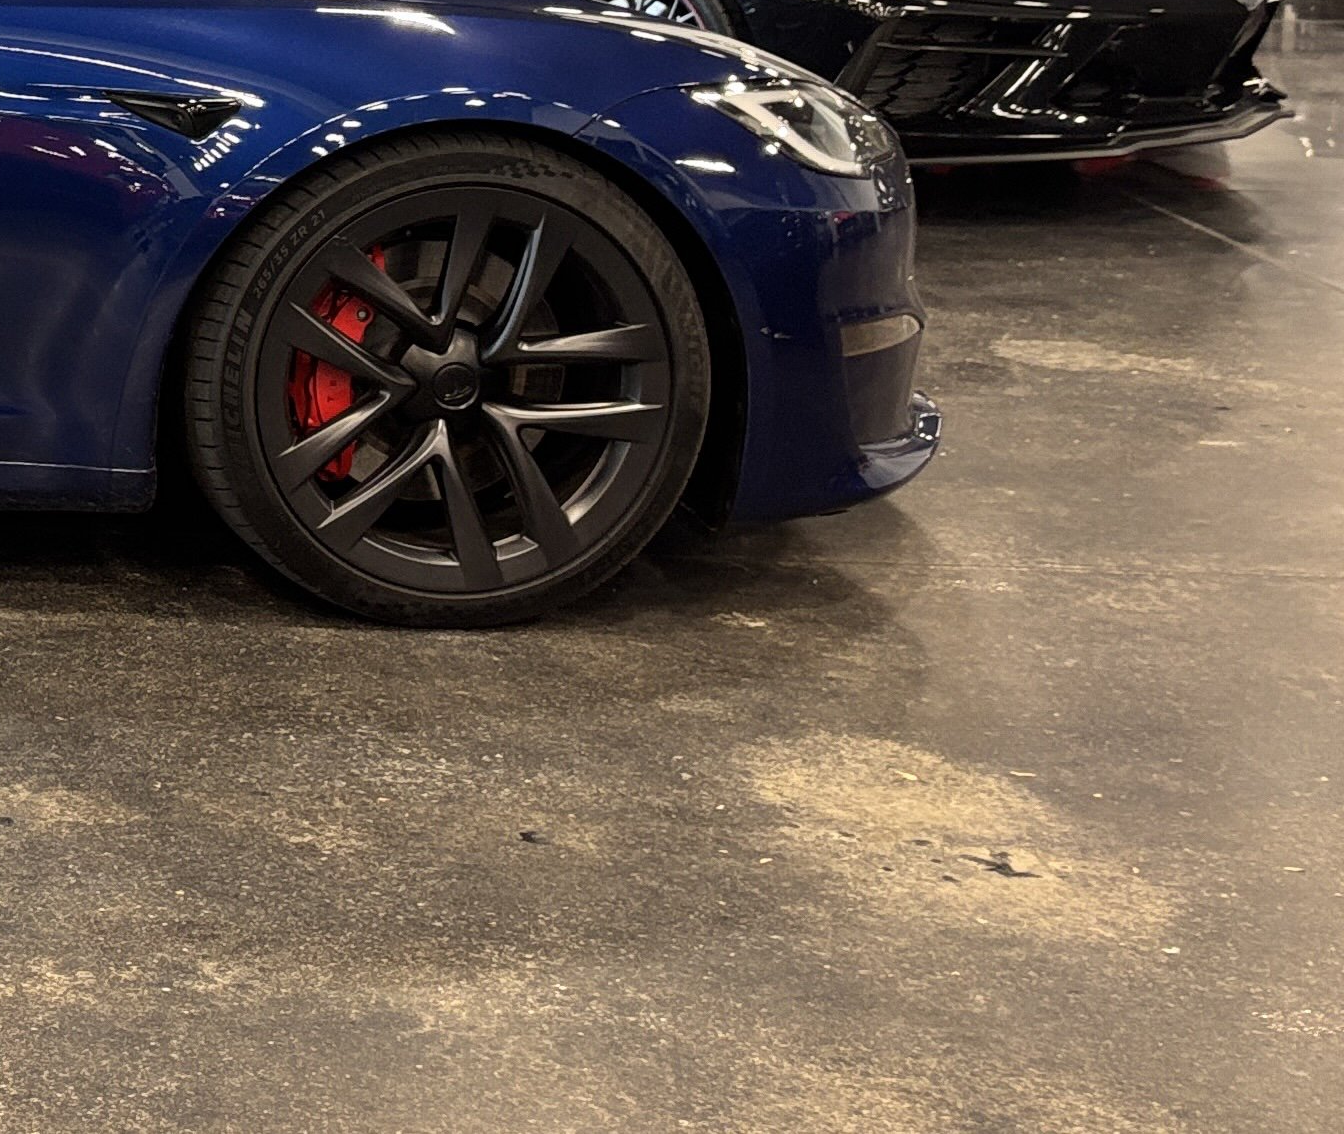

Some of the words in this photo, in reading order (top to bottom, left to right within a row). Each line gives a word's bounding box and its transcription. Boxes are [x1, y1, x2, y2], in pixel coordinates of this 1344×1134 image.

[253, 246, 289, 300] 265/35
[288, 224, 309, 247] ZR
[311, 208, 327, 227] 21
